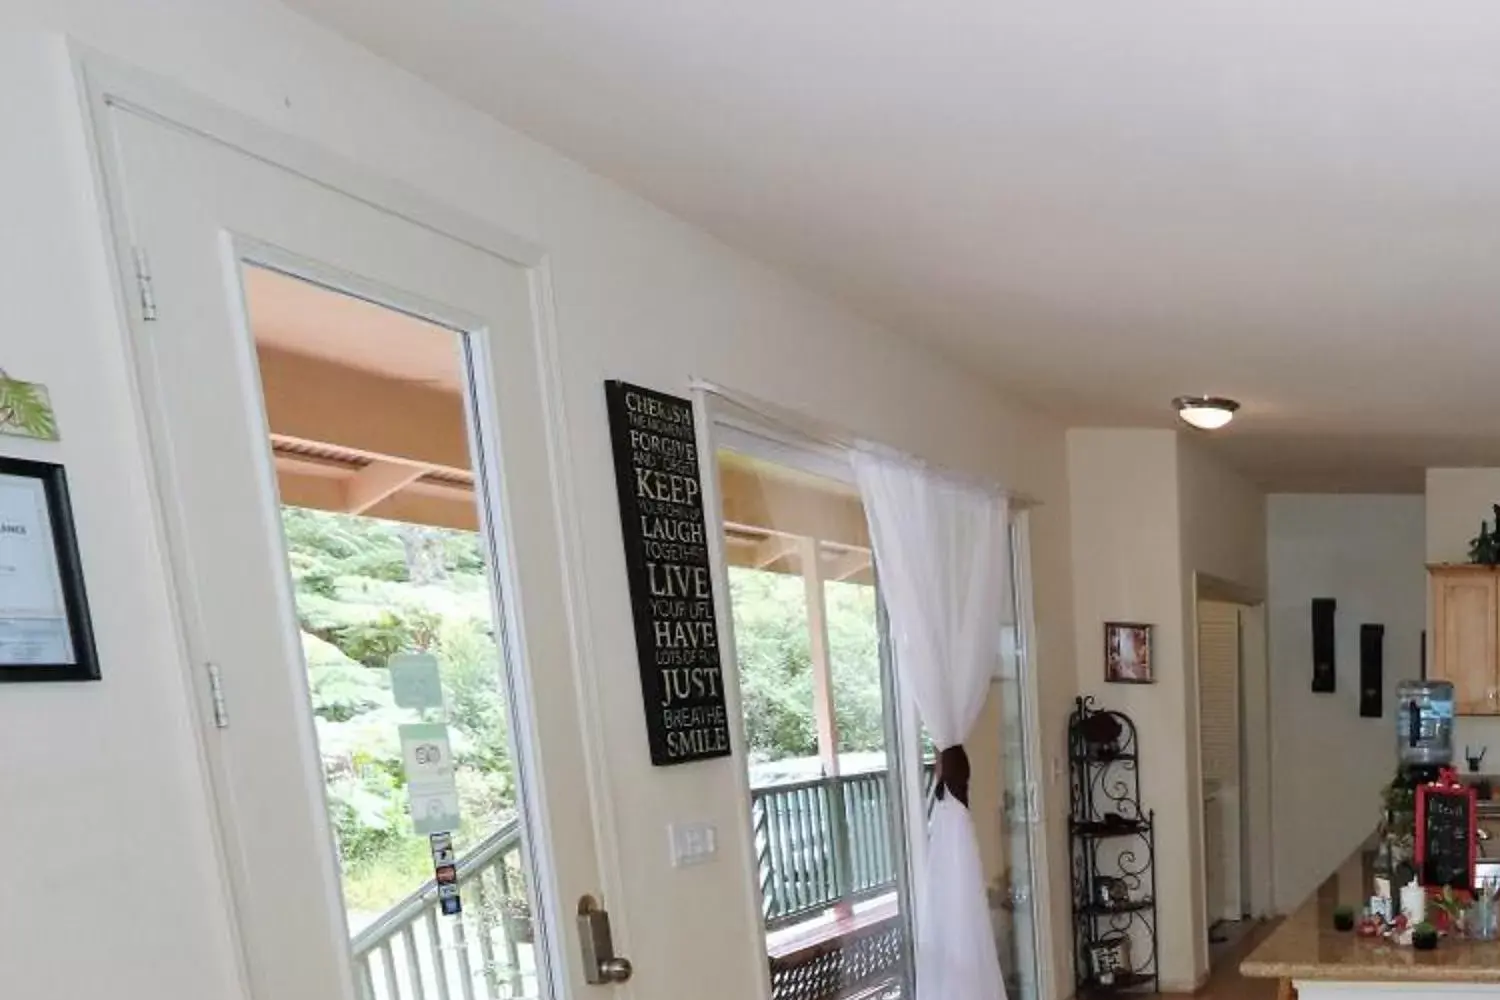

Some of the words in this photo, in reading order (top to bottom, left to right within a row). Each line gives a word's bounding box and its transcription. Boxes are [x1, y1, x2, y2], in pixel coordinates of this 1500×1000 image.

[625, 392, 691, 425] CHERISH
[630, 430, 695, 461] FORGIVE
[635, 468, 698, 505] KEEP
[641, 516, 703, 544] LAUGH
[647, 563, 709, 598] LIVE
[654, 621, 715, 648] HAVE
[661, 667, 719, 707] JUST
[663, 705, 725, 729] BREATHE
[666, 727, 728, 757] SMILE
